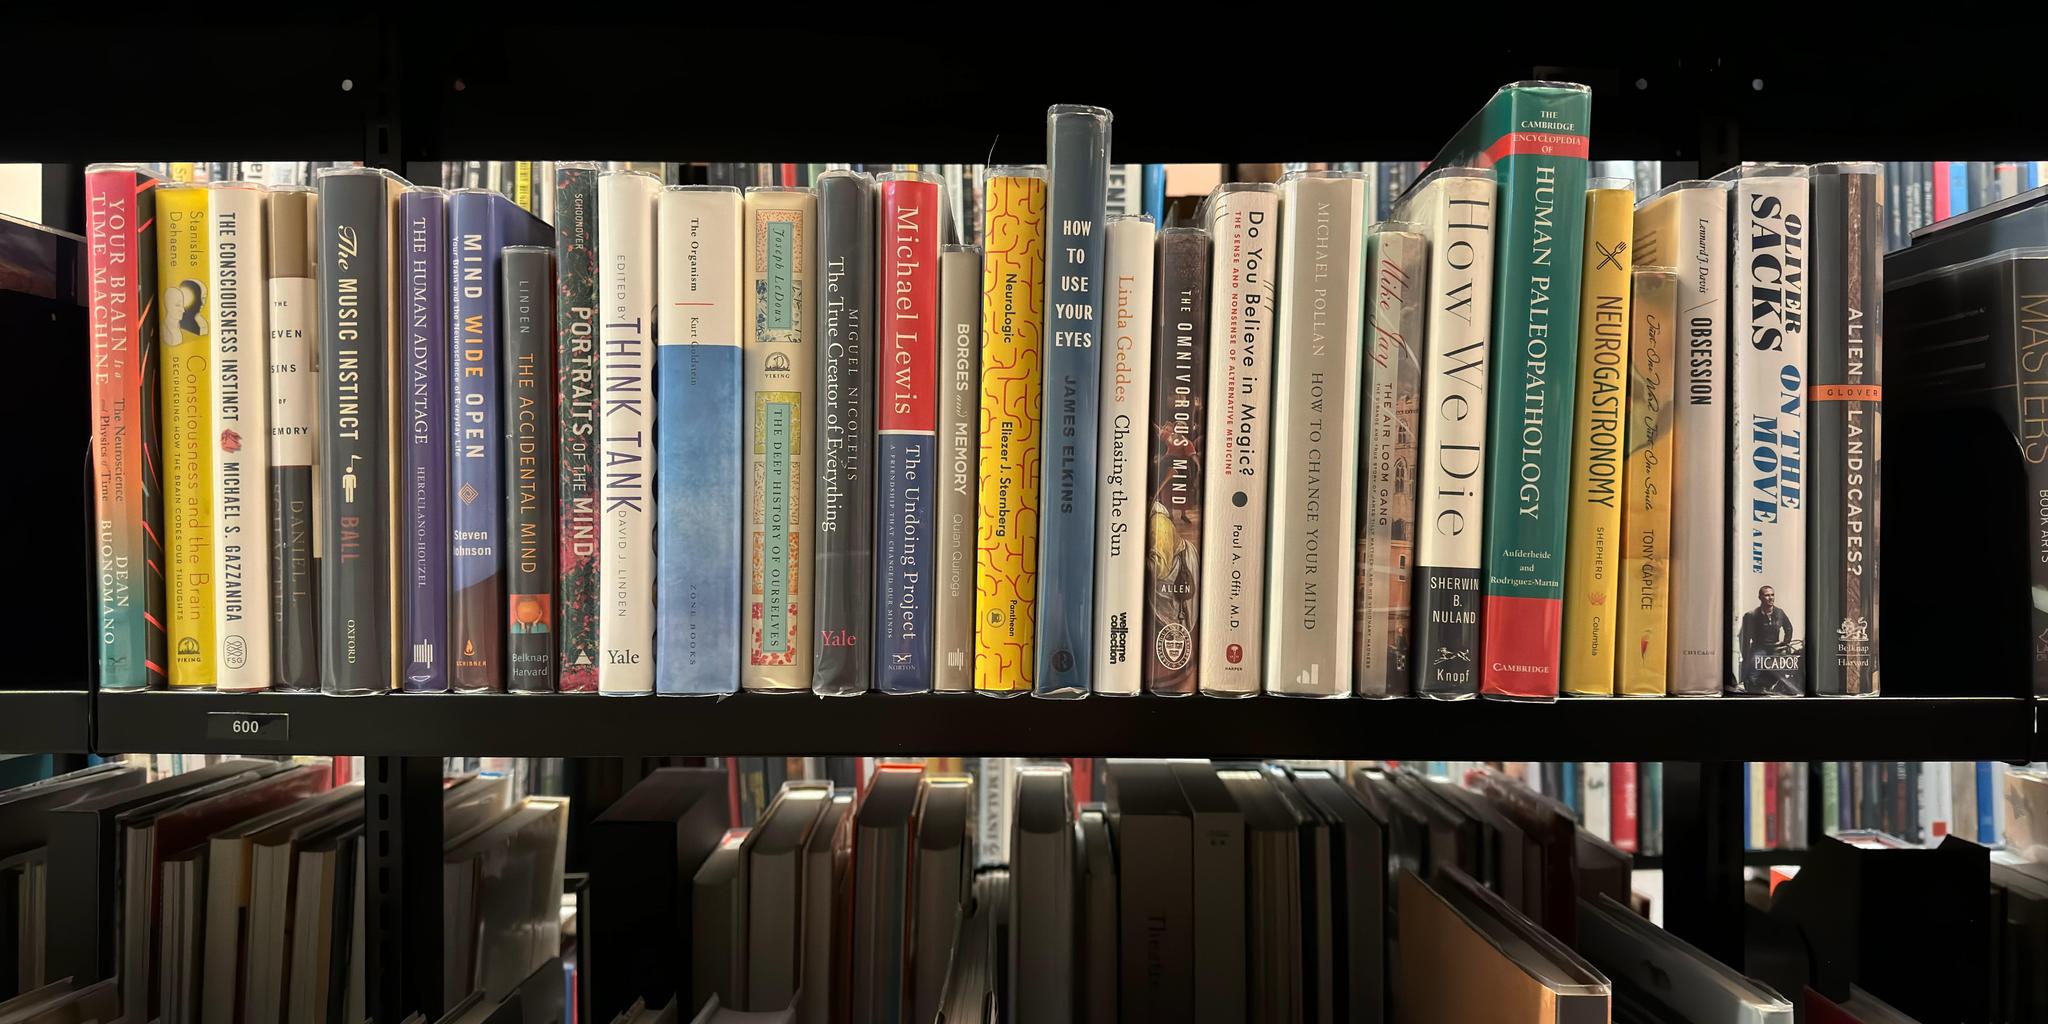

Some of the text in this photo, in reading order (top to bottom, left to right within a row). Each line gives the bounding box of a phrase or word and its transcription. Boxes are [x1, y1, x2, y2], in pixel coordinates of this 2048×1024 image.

[1513, 134, 1581, 145] ENCYCLOPEDIA
[1521, 120, 1575, 132] CAMBRIDGE
[170, 211, 182, 268] Dehaene
[190, 211, 204, 267] Stanislas
[574, 193, 584, 250] SCHOONOVER
[688, 218, 699, 292] The Organism
[1234, 212, 1242, 228] THE
[92, 192, 109, 385] TIME MACHINE
[109, 197, 127, 352] YOUR BRAIN
[520, 280, 530, 333] LINDEN
[617, 255, 626, 320] EDITED BY
[773, 228, 786, 322] Joseph LeDoux
[895, 206, 920, 414] Michael Lewis
[1232, 268, 1240, 288] AND
[1312, 202, 1330, 356] MICHAEL POLLAN
[1368, 242, 1410, 368] Mike Jay
[1699, 266, 1709, 294] Davis
[1751, 194, 1782, 352] SACKS
[1785, 214, 1802, 334] OLIVER
[220, 242, 239, 422] CONSCIOUSNESS INSTINCT
[338, 225, 358, 440] The MUSIC INSTINCT
[464, 234, 485, 458] MIND WIDE OPEN
[1056, 304, 1093, 320] YOUR
[1056, 332, 1092, 348] EYES
[1116, 275, 1134, 402] Linda Geddes
[1230, 294, 1238, 346] NONSENSE
[1520, 166, 1555, 520] HUMAN PALEOPATHOLOGY
[1848, 307, 1864, 376] ALIEN
[414, 260, 428, 444] HUMAN ADVANTAGE
[690, 317, 699, 386] Kurt Goldstein
[1230, 350, 1236, 361] OF
[1236, 248, 1262, 476] You Believe Magic?
[1437, 195, 1490, 536] How We Die
[1690, 318, 1712, 405] OBSESSION
[572, 306, 593, 556] PORTRAITS MIND
[606, 318, 642, 513] THINK TANK
[822, 256, 844, 532] The True Creator Everything
[848, 308, 859, 481] MIGUEL NICOLELIS
[954, 324, 969, 496] BORGES MEMORY
[1172, 322, 1192, 504] OMNIVOROUS MIND
[1226, 366, 1236, 425] ALTERNATIVE
[1588, 296, 1622, 508] NEUROGASTRONOMY
[1827, 389, 1878, 397] GLOVER
[114, 425, 126, 502] Neuroscience
[518, 353, 536, 573] THE ACCIDENTAL MIND
[1061, 376, 1076, 514] JAMES ELKINS
[1225, 428, 1234, 476] MEDICINE
[1379, 383, 1392, 526] THE AIR LOOM GANG
[1753, 414, 1778, 524] MOVE
[1780, 364, 1800, 510] ON THE
[172, 357, 180, 422] DECIPHERING
[176, 569, 184, 621] THOUGHTS
[186, 355, 210, 620] Consciousness and the Brain
[996, 477, 1012, 538] Sternberg
[1108, 414, 1130, 558] Chasing Sun
[1644, 477, 1657, 513] Smile
[1847, 410, 1864, 576] LANDSCAPES?
[224, 462, 242, 622] MICHAEL GAZZANIGA
[290, 501, 305, 582] DANIEL
[340, 516, 360, 564] BALL
[416, 466, 426, 588] HERCULANO-HOUZEL
[454, 530, 488, 540] Steven
[618, 510, 627, 618] DAVID LINDEN
[770, 409, 782, 647] THE DEEP HISTORY OF OURSELVES
[900, 444, 920, 640] The Undoing Project
[1230, 524, 1242, 600] Paul A. Offit,
[1304, 450, 1321, 630] CHANGE YOUR MIND
[1753, 542, 1762, 574] LIFE
[101, 520, 114, 644] BUONOMANO
[116, 556, 129, 608] DEAN
[950, 551, 962, 597] Quiroga
[1161, 584, 1190, 593] ALLEN
[1430, 576, 1480, 591] SHERWIN
[1453, 595, 1462, 607] B.
[1520, 564, 1535, 572] and
[1641, 530, 1654, 610] TONY CAPLICE
[348, 620, 356, 664] OXFORD
[822, 630, 856, 646] Yale
[1009, 600, 1018, 637] Pantheon
[1110, 614, 1118, 664] collection
[1118, 612, 1128, 662] wellcome
[1432, 610, 1476, 624] NULAND
[1592, 616, 1600, 656] Columbia
[512, 653, 549, 662] Belknap
[513, 668, 548, 676] Harvard
[1492, 662, 1550, 674] CAMBRIDGE
[1755, 656, 1799, 670] PICADOR
[233, 720, 258, 732] 600
